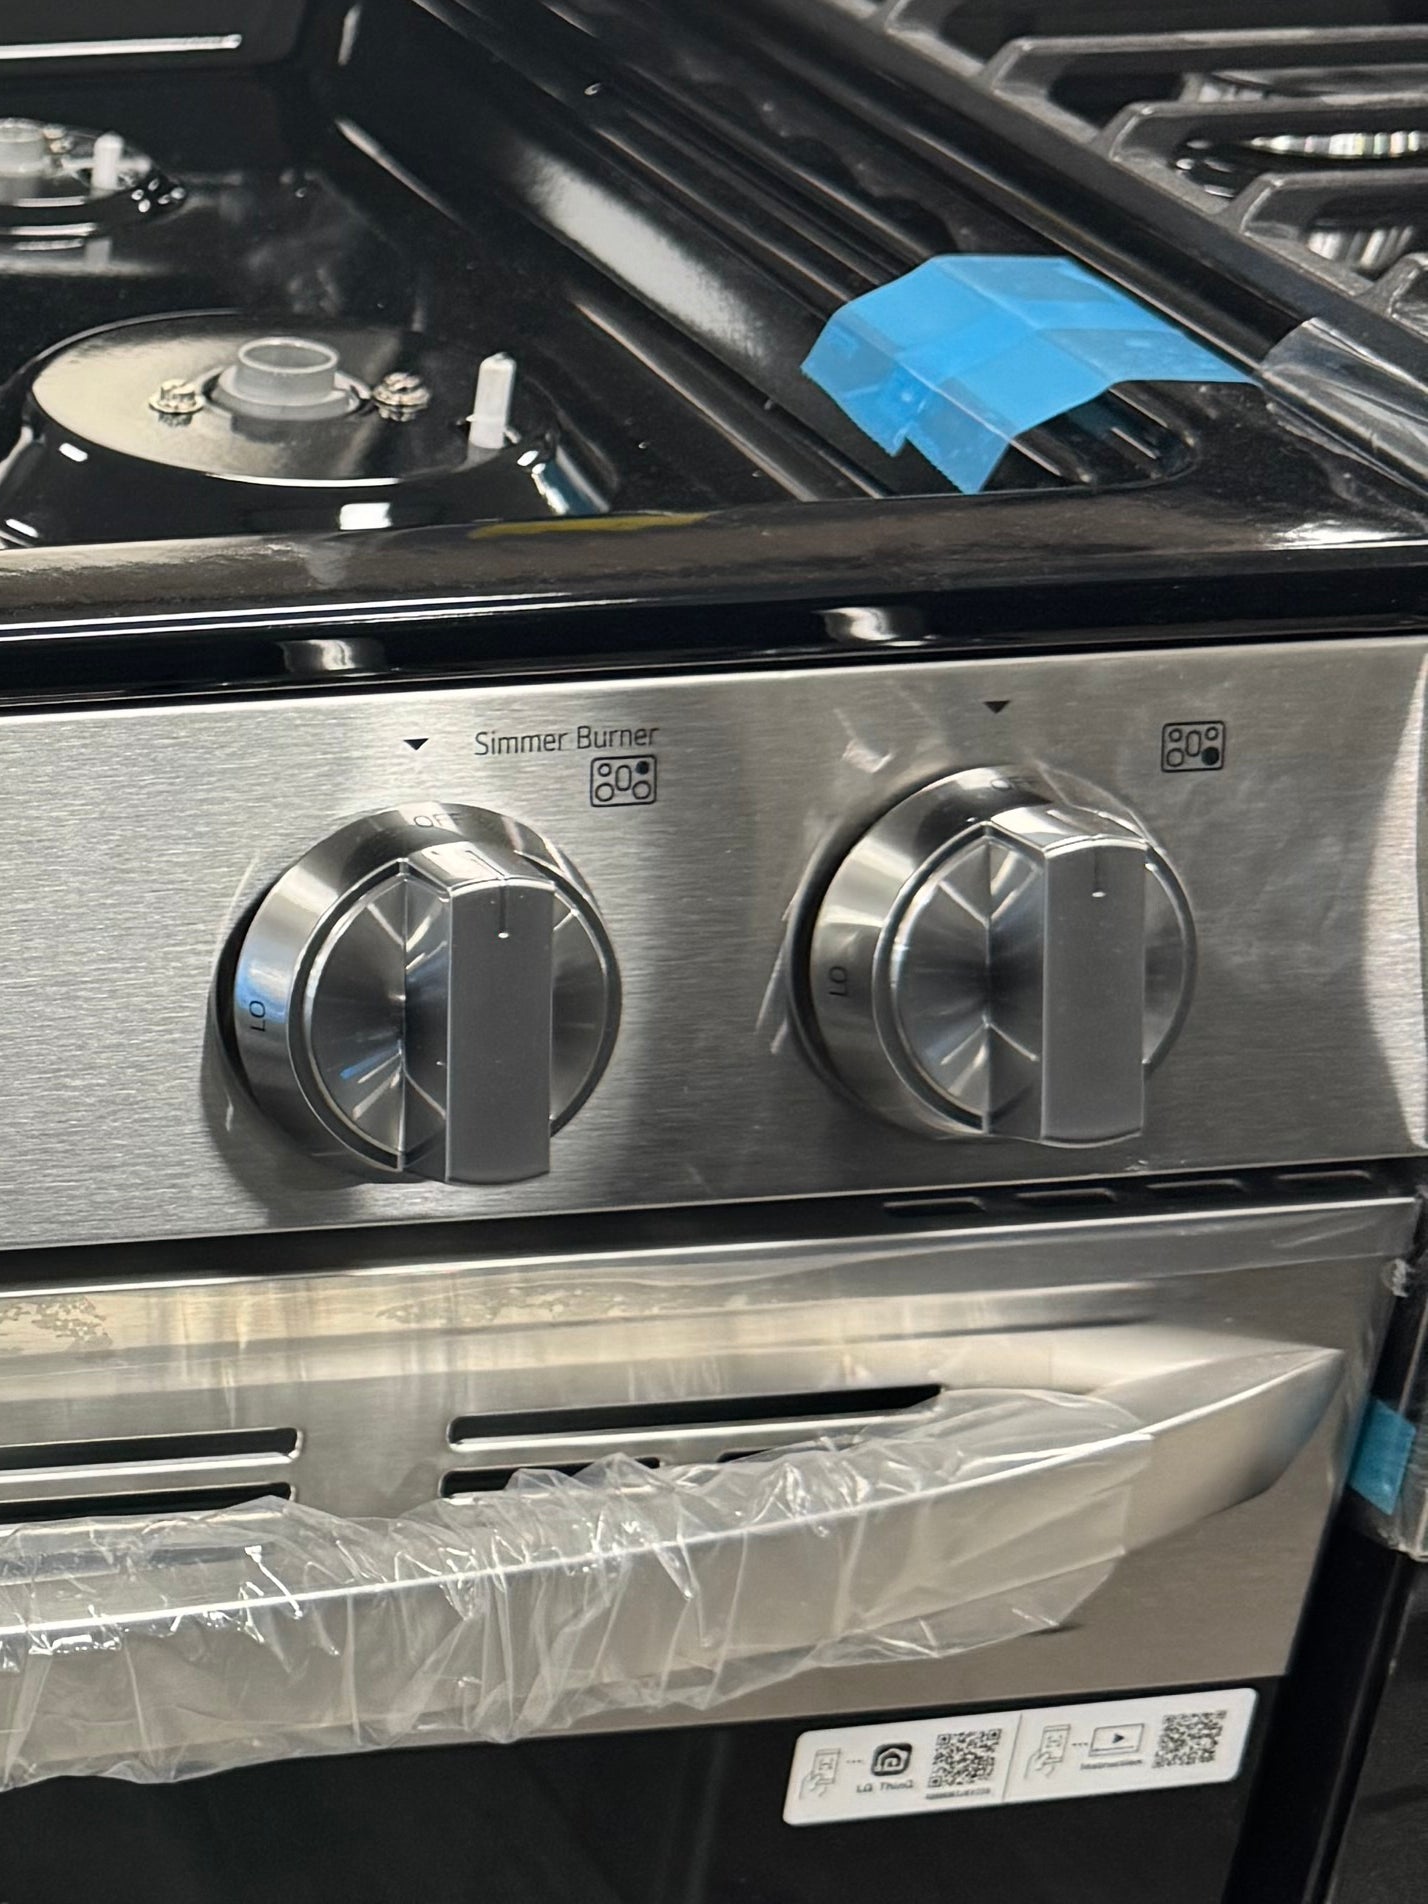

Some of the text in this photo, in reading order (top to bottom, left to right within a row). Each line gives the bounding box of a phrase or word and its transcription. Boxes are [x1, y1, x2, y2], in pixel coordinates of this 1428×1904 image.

[474, 725, 660, 756] Simmer Burner
[829, 965, 850, 998] LO
[248, 999, 267, 1034] LO
